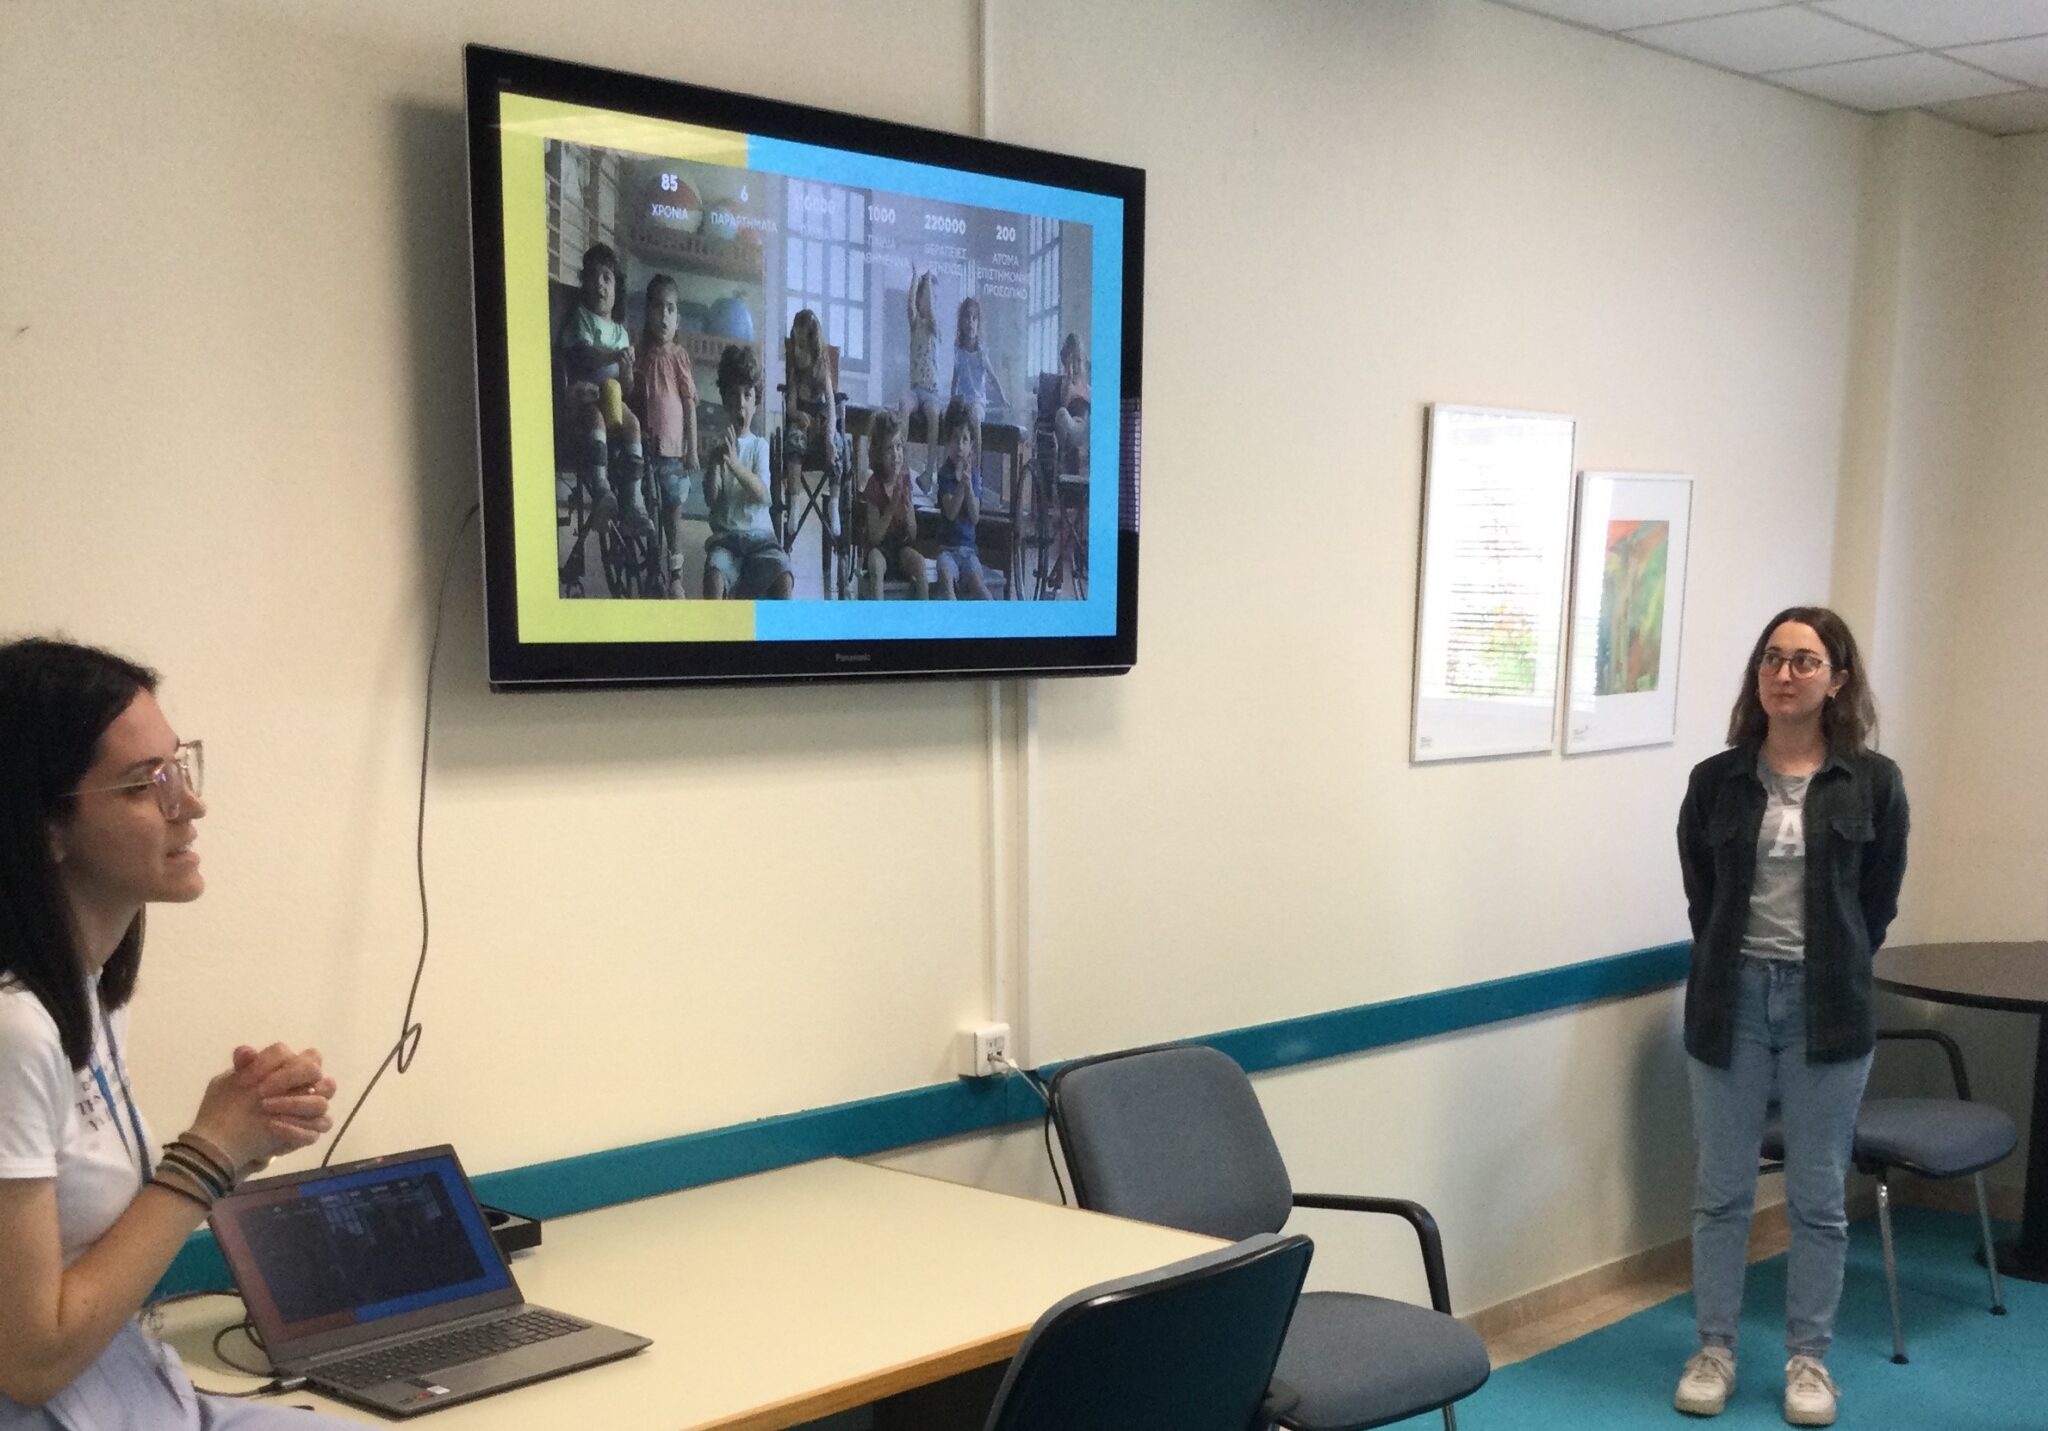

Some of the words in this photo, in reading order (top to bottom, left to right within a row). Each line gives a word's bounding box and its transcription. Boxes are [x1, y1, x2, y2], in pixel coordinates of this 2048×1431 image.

[661, 173, 678, 192] 85
[740, 185, 749, 202] 6
[651, 203, 689, 220] ΧΡΟΝΙΑ
[868, 205, 896, 224] 1000
[924, 214, 967, 235] 220000
[996, 225, 1016, 242] 200
